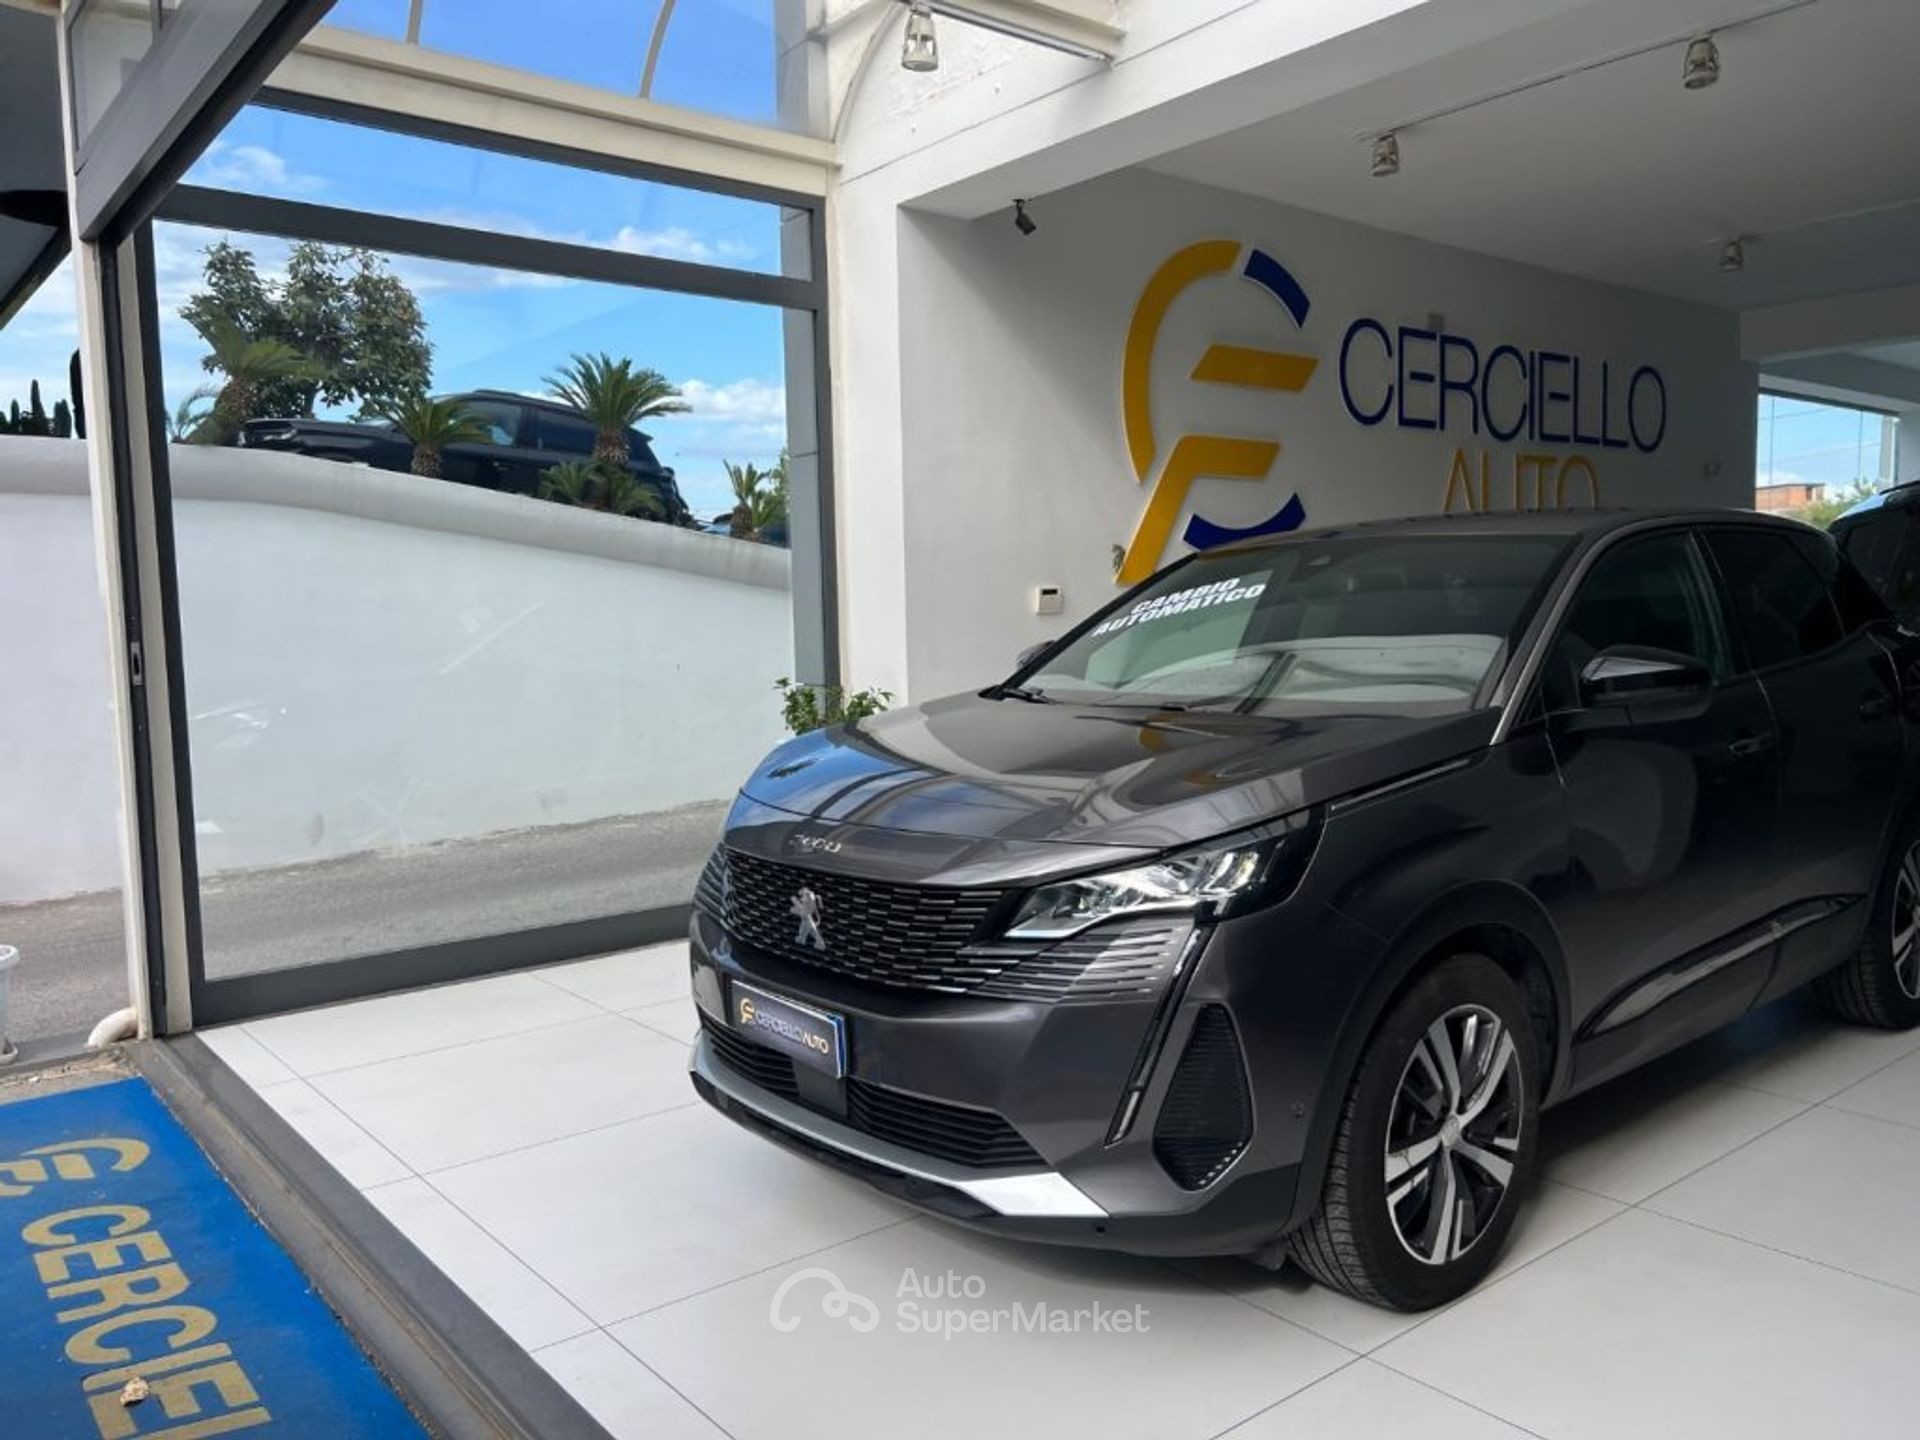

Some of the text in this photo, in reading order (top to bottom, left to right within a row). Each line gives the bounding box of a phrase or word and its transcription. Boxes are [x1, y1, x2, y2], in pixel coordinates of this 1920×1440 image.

[1339, 317, 1667, 453] CERCIELLO
[1091, 584, 1267, 637] AUTOMATICO
[1130, 577, 1241, 615] CAMBIO
